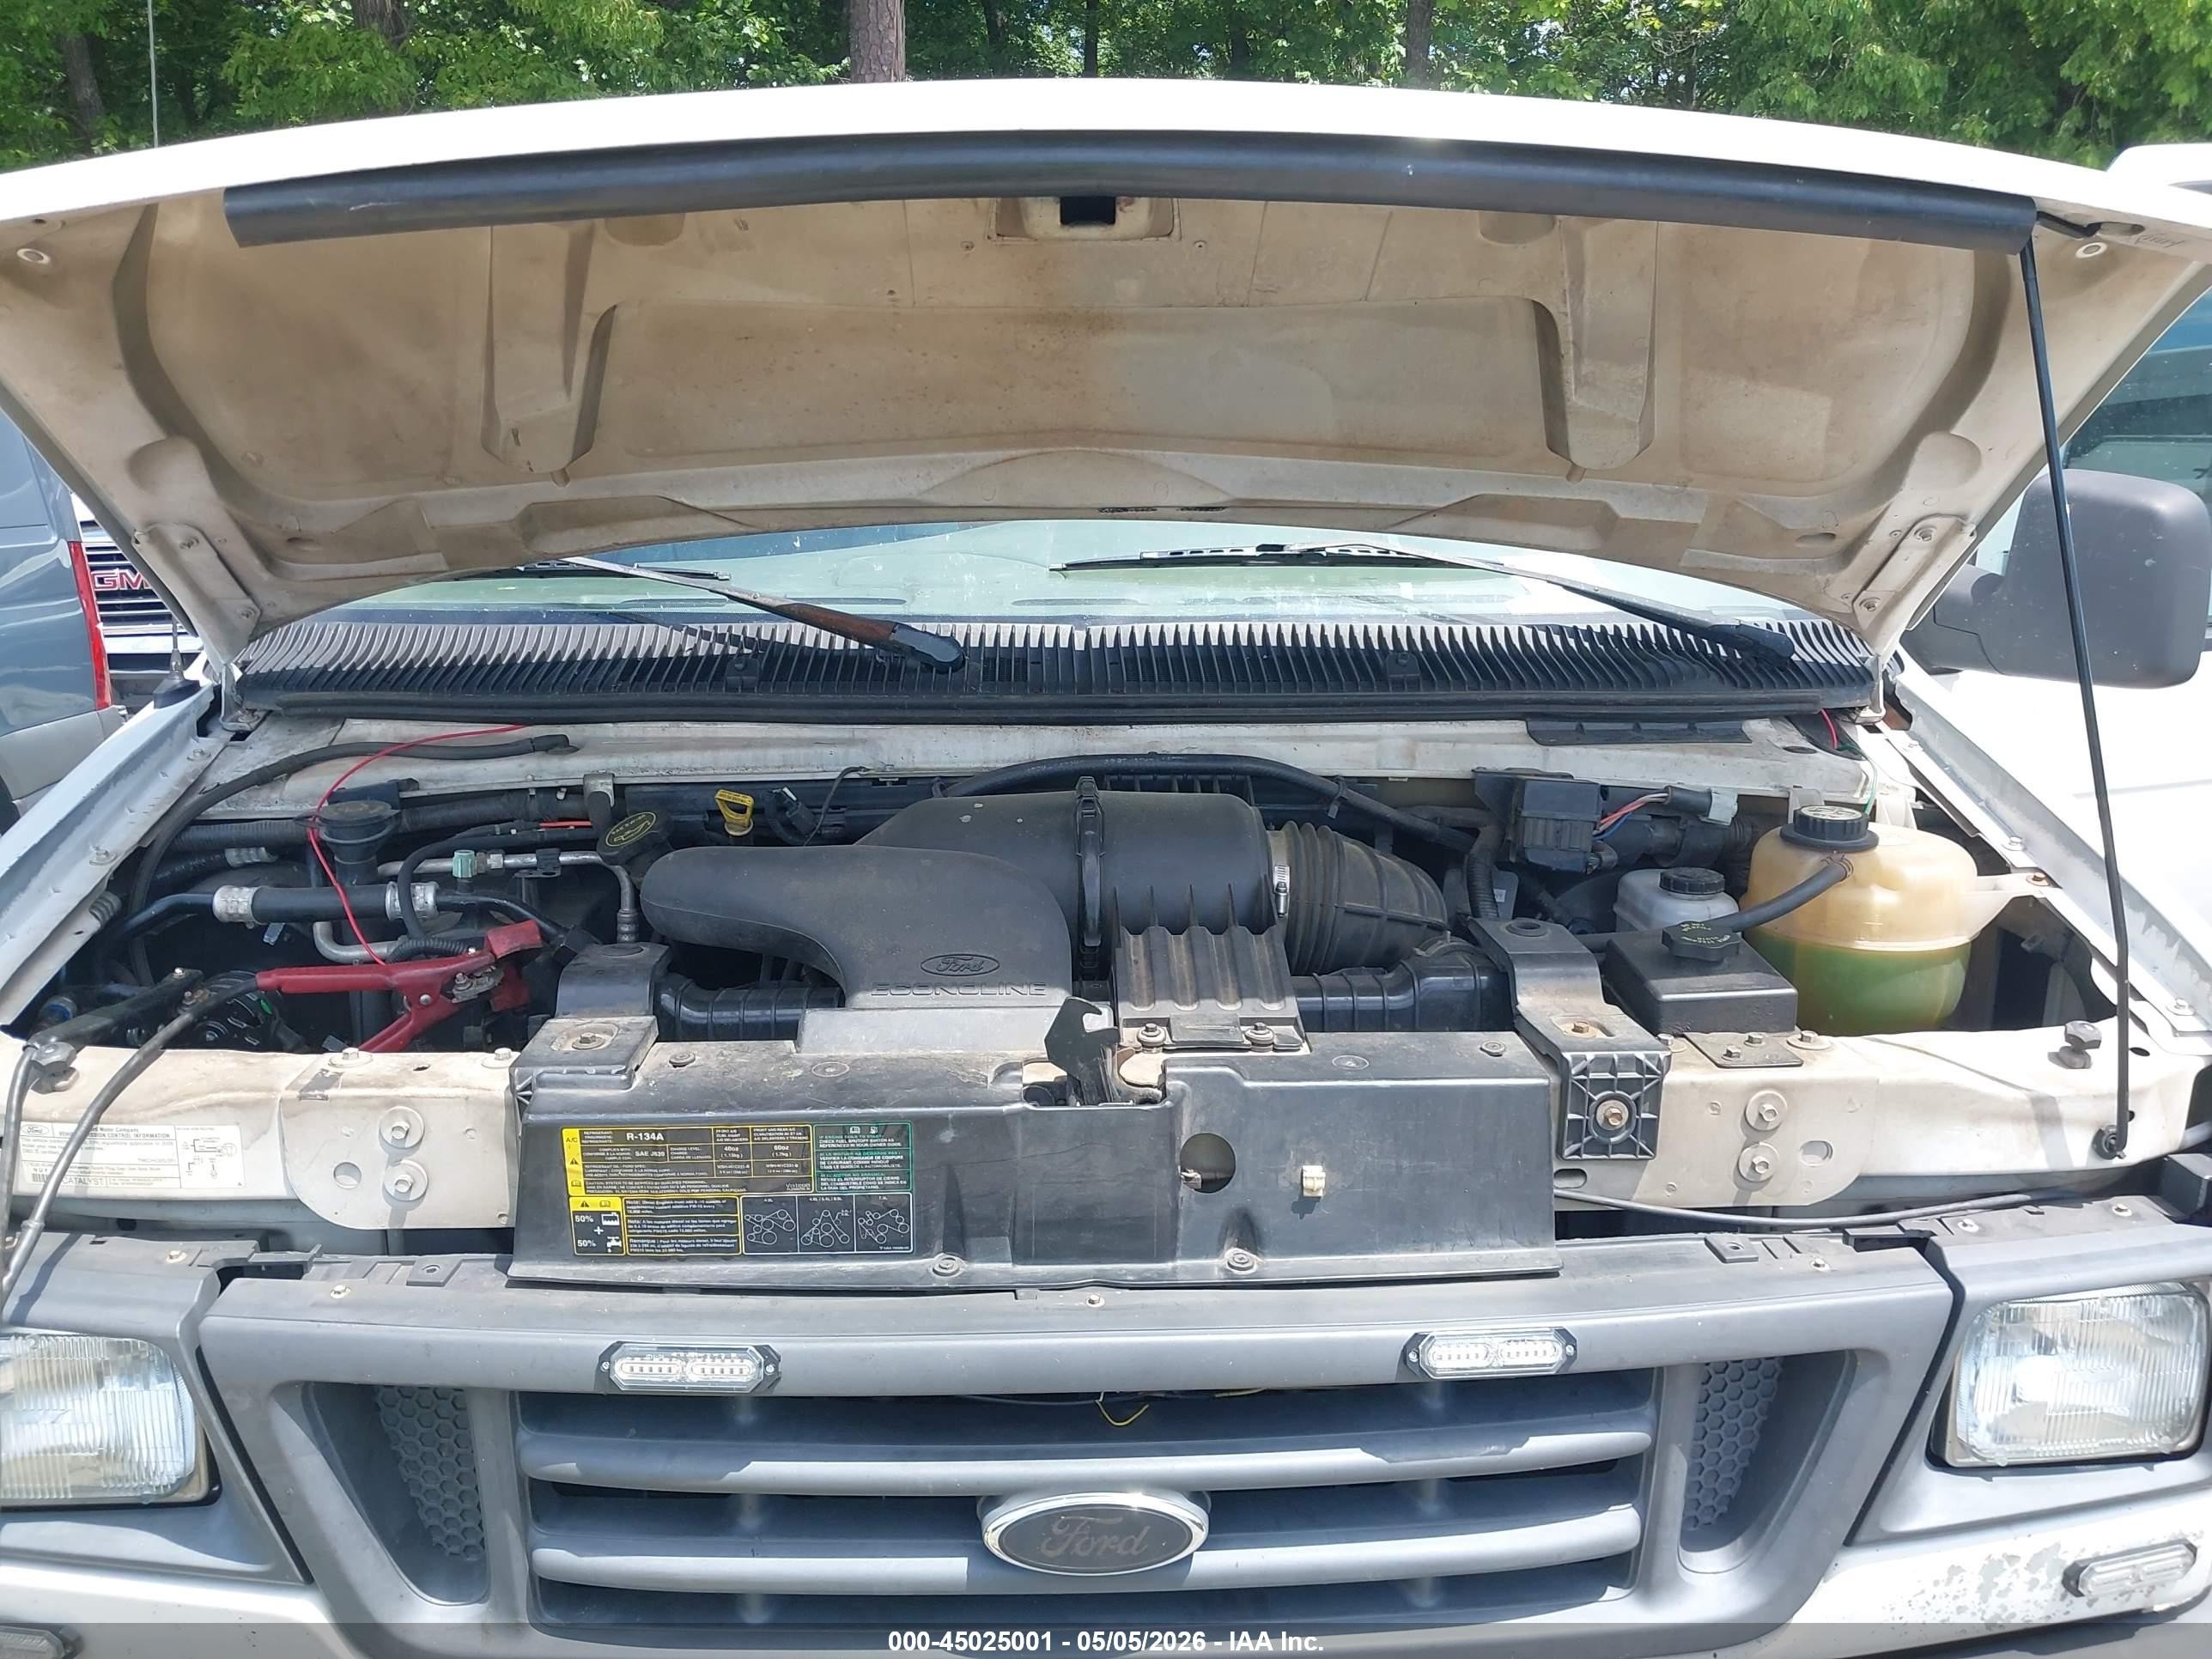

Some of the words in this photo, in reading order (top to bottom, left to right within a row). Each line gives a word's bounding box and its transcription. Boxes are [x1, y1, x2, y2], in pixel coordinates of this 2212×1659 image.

[936, 957, 984, 972] Ford
[871, 981, 1047, 996] ECONOLINE
[626, 1132, 665, 1141] R-134A
[63, 1176, 104, 1186] CATALYST
[574, 1214, 594, 1223] 50%
[577, 1239, 596, 1248] 50%
[1040, 1516, 1152, 1559] Ford
